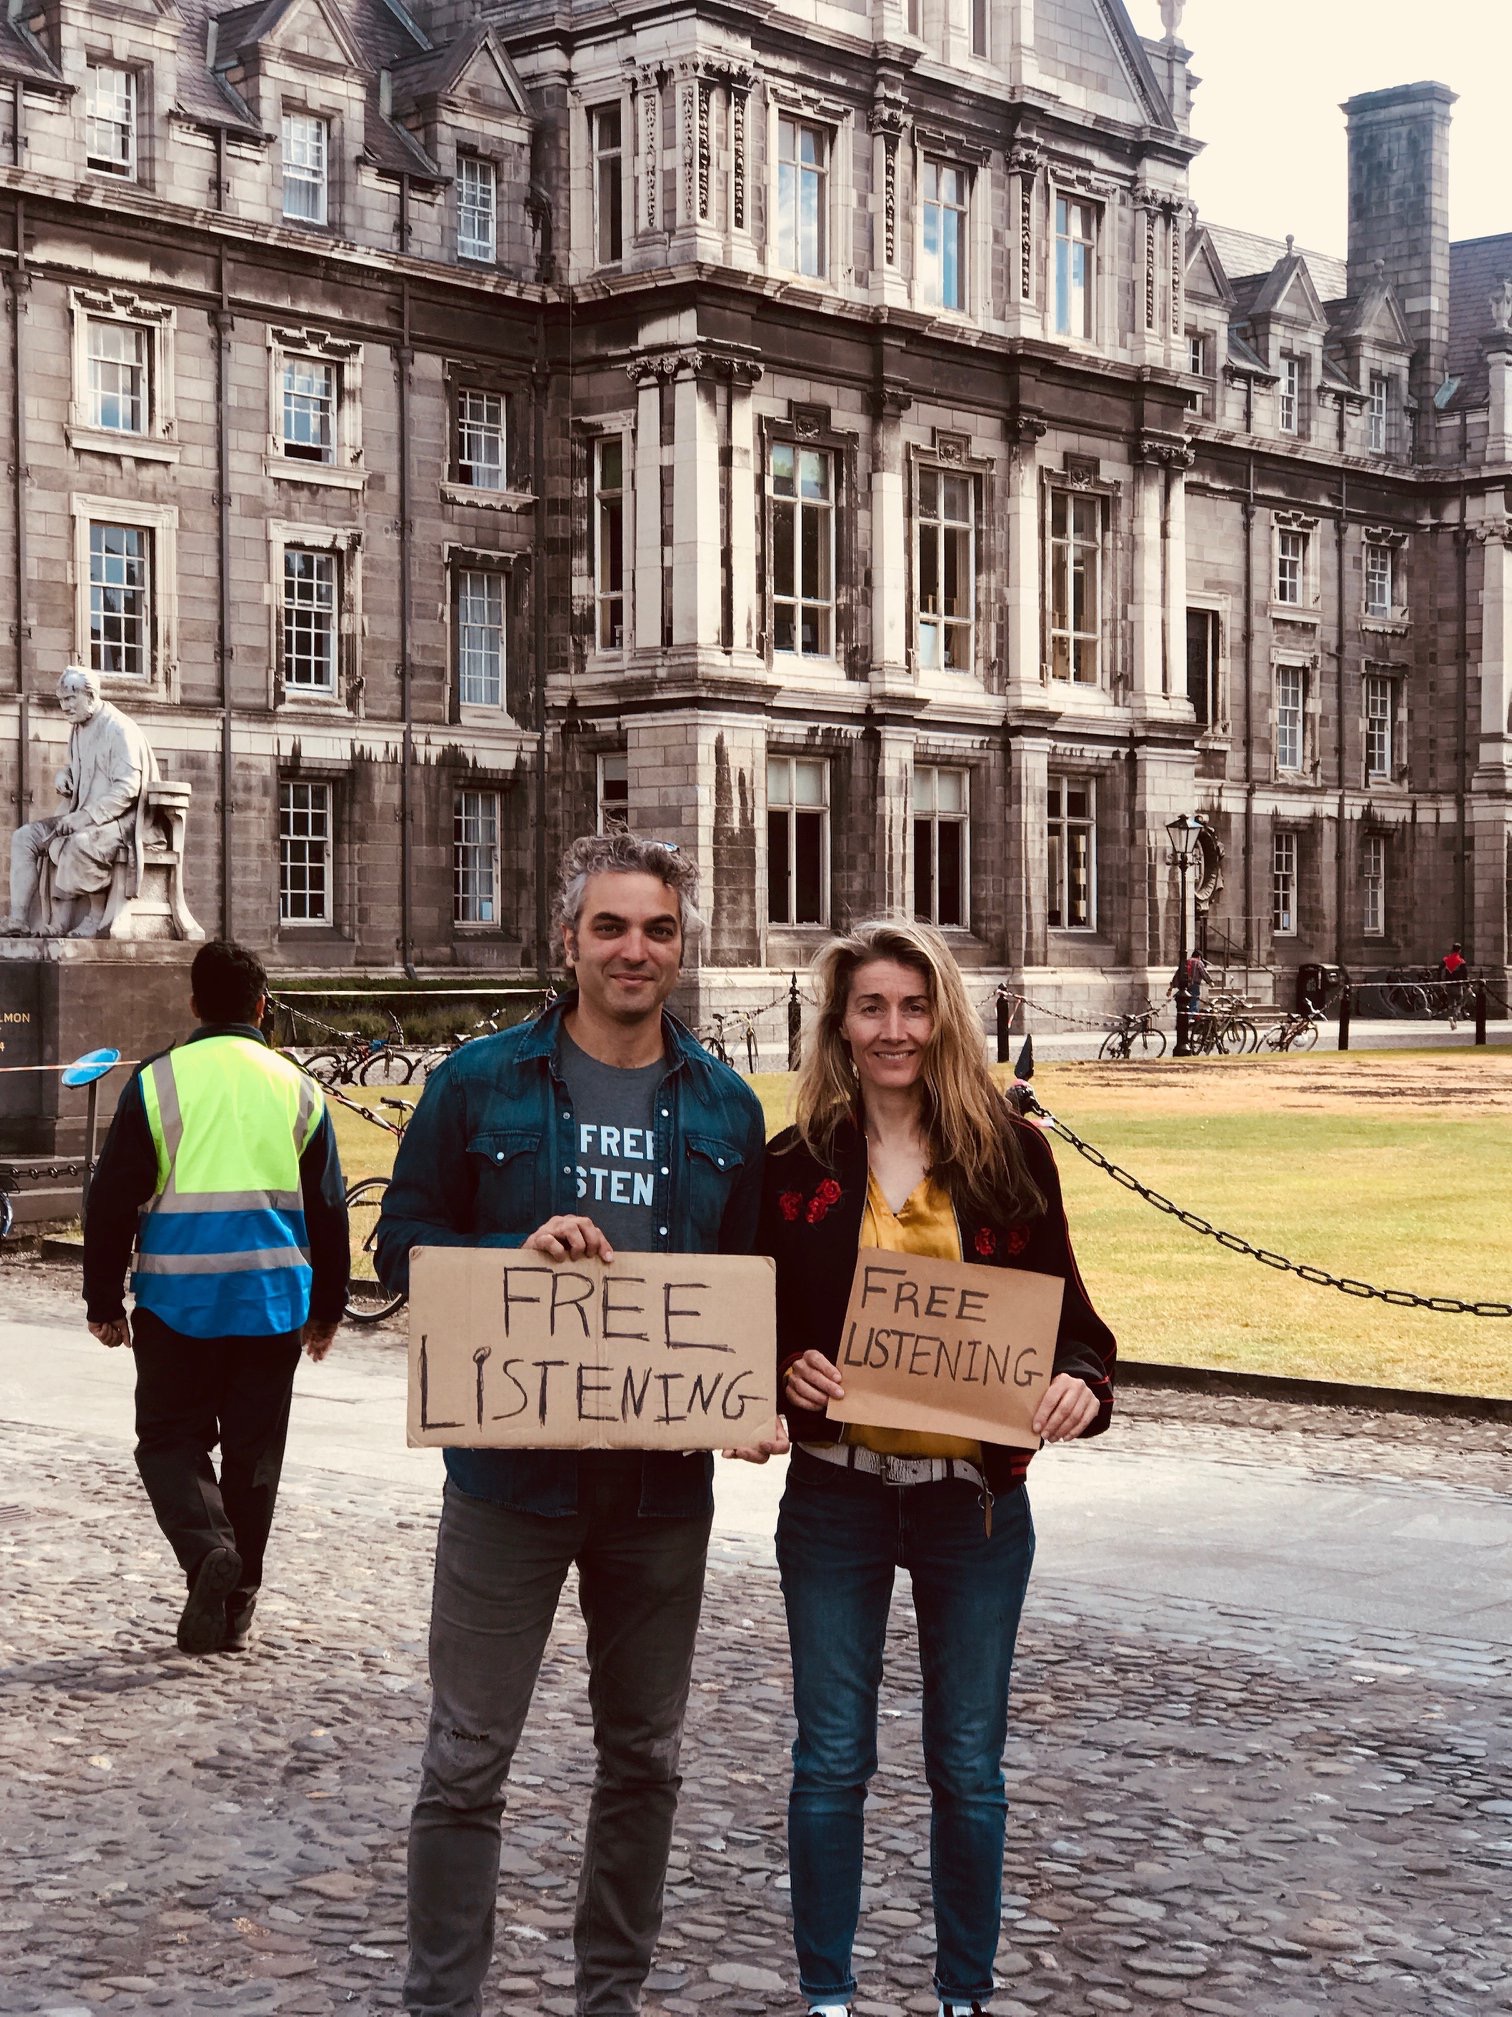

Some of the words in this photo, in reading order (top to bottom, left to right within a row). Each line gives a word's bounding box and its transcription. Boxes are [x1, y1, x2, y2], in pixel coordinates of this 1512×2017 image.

[503, 1266, 736, 1353] FREE
[861, 1266, 989, 1323] FREE
[843, 1321, 1044, 1387] LISTENING
